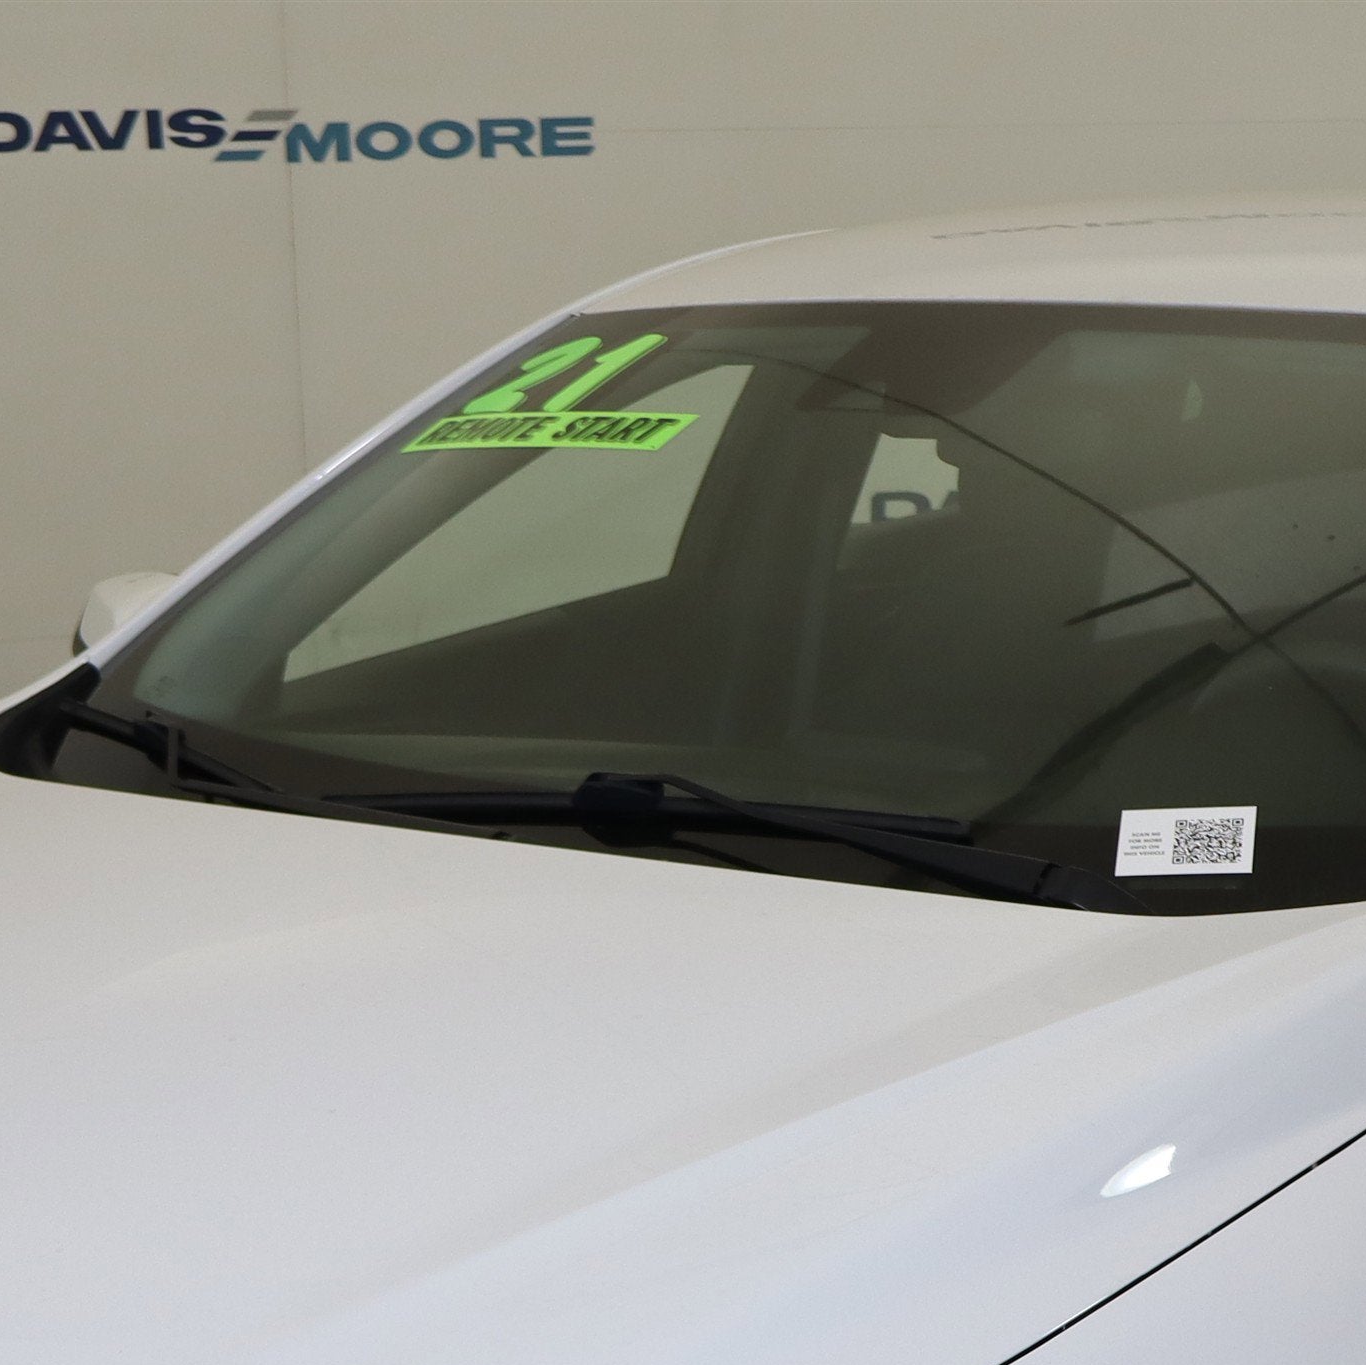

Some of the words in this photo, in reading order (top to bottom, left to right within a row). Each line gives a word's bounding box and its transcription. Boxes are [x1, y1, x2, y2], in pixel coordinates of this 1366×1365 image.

[285, 117, 592, 163] MOORE
[462, 333, 669, 413] 21
[421, 416, 562, 444] REMOTE
[552, 416, 680, 443] START
